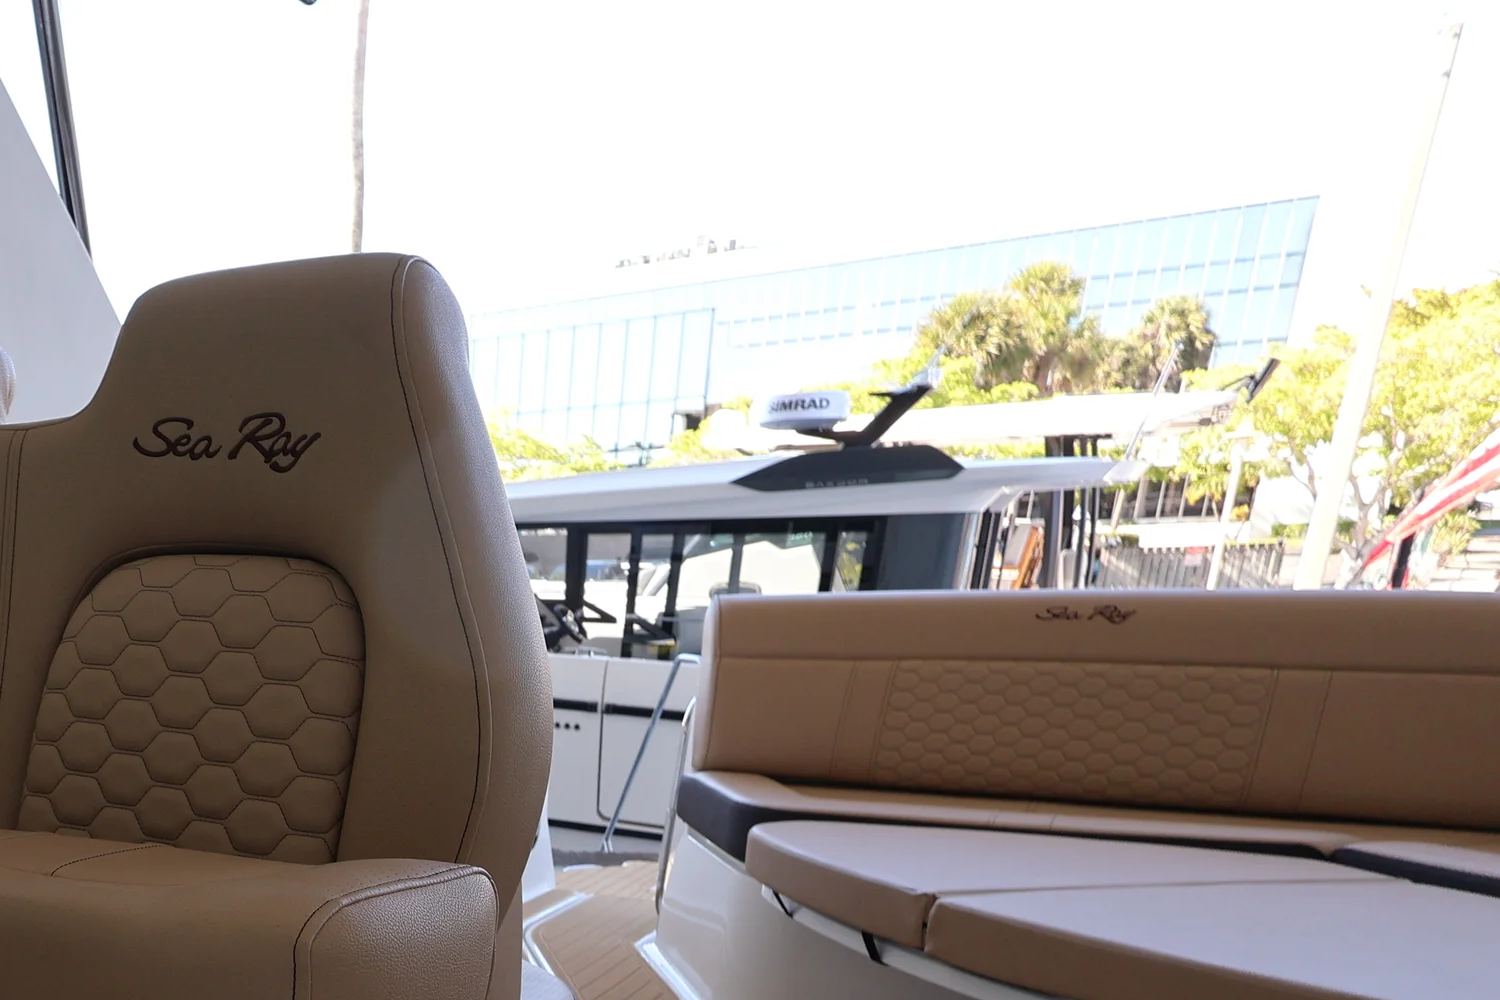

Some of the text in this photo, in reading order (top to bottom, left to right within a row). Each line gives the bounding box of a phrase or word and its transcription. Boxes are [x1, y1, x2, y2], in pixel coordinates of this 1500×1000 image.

[768, 397, 830, 414] SIMRAD
[133, 412, 322, 473] Sea Ray
[1035, 604, 1138, 625] Sea Ray
